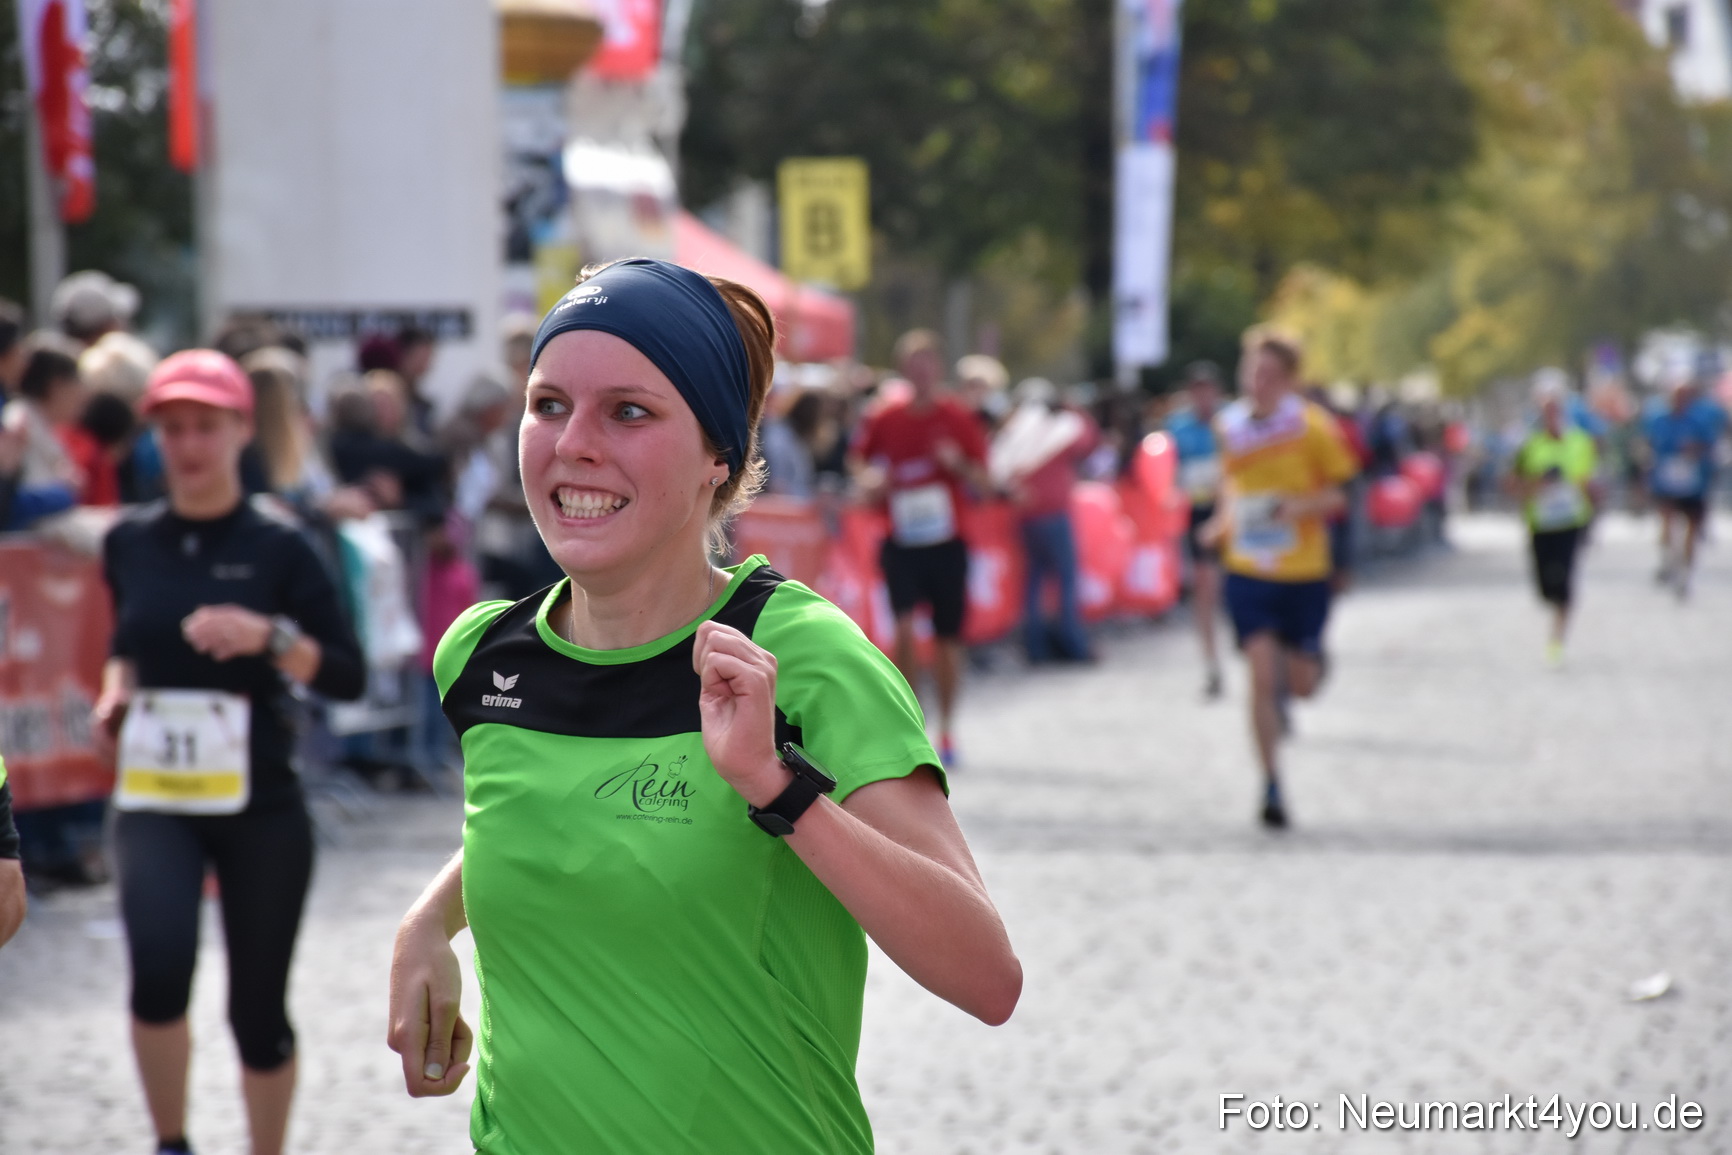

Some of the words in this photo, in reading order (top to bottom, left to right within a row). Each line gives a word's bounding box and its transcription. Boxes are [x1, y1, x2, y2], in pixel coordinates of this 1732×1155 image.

[481, 693, 522, 709] erima
[594, 753, 697, 813] Rein
[638, 795, 689, 812] catering
[615, 813, 694, 826] www.catering-rein.de
